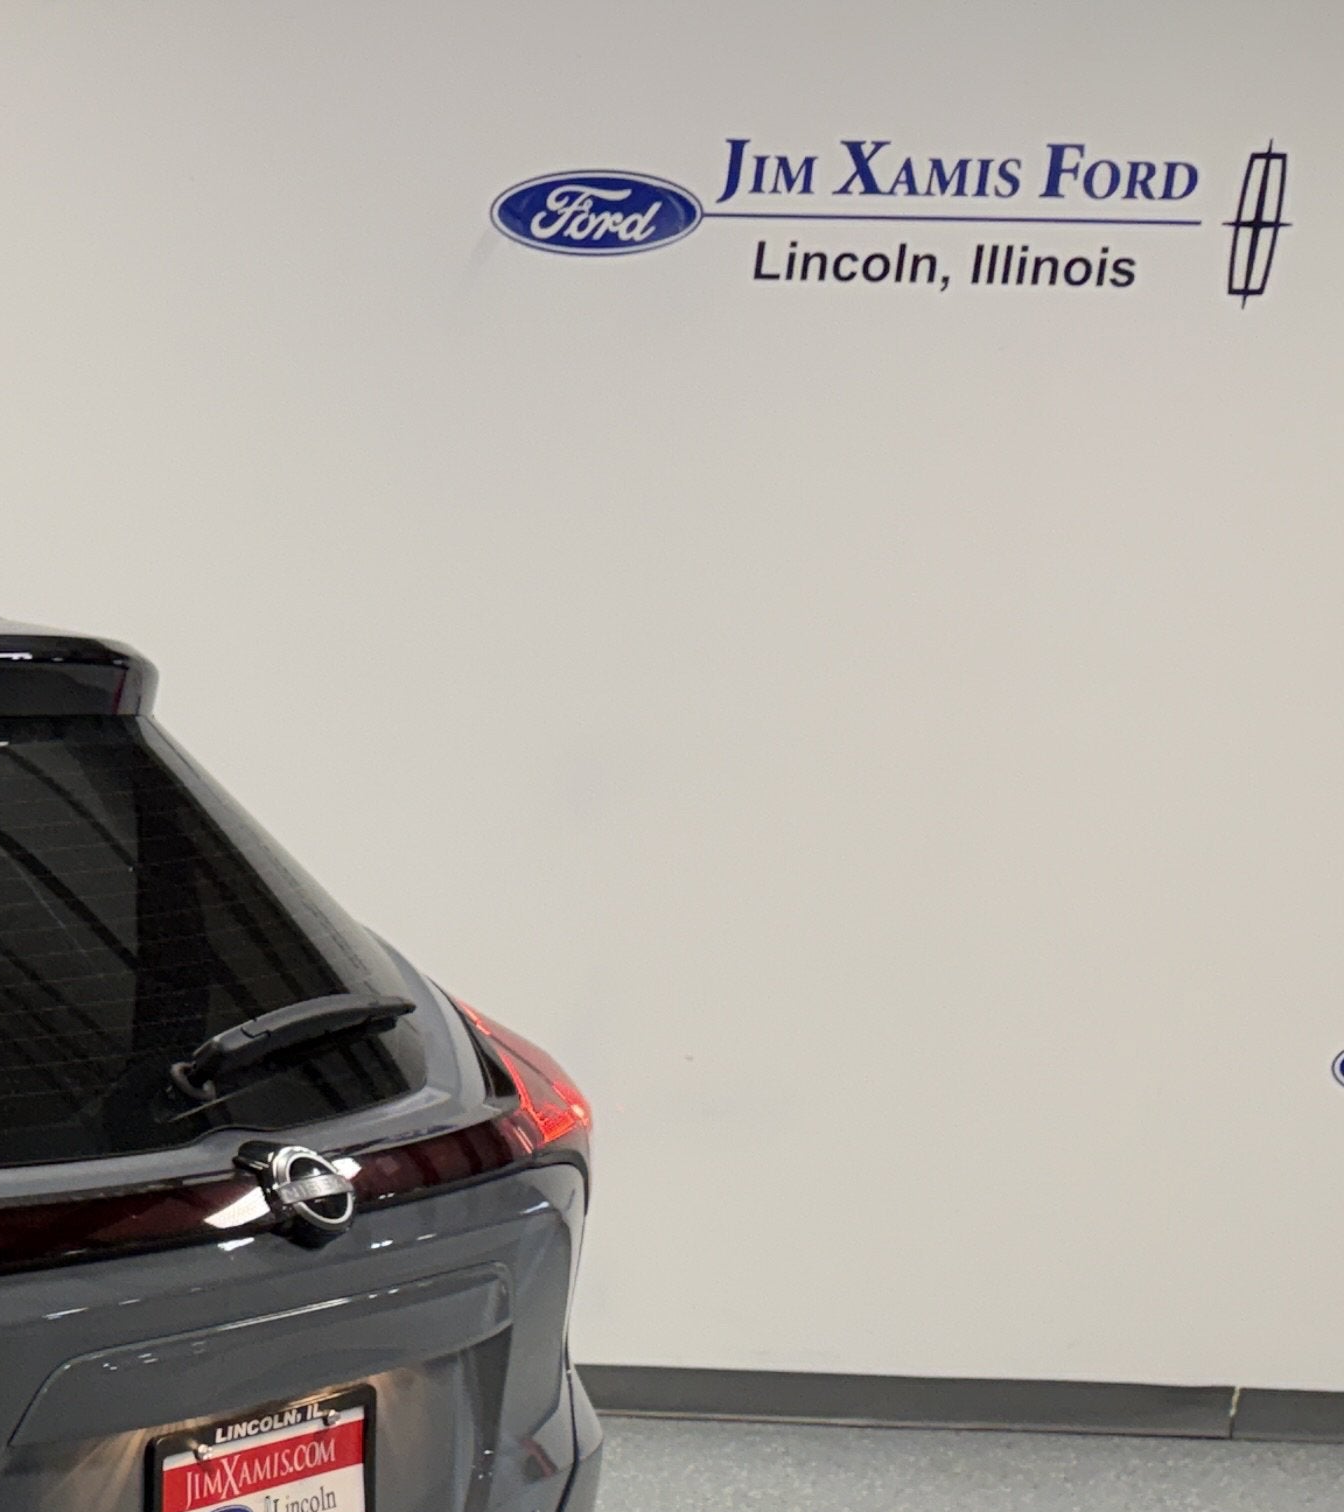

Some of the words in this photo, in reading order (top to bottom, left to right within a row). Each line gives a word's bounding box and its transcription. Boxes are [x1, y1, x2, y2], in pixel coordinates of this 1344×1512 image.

[716, 138, 818, 204] JIM
[832, 140, 1022, 198] XAMIS
[1038, 143, 1199, 201] FORD
[530, 186, 660, 242] Ford
[752, 240, 950, 292] Lincoln,
[970, 244, 1136, 288] Illinois
[215, 1408, 303, 1444] LINCOLN,
[306, 1402, 323, 1420] IL
[186, 1438, 337, 1511] JIMXAMIS.COM
